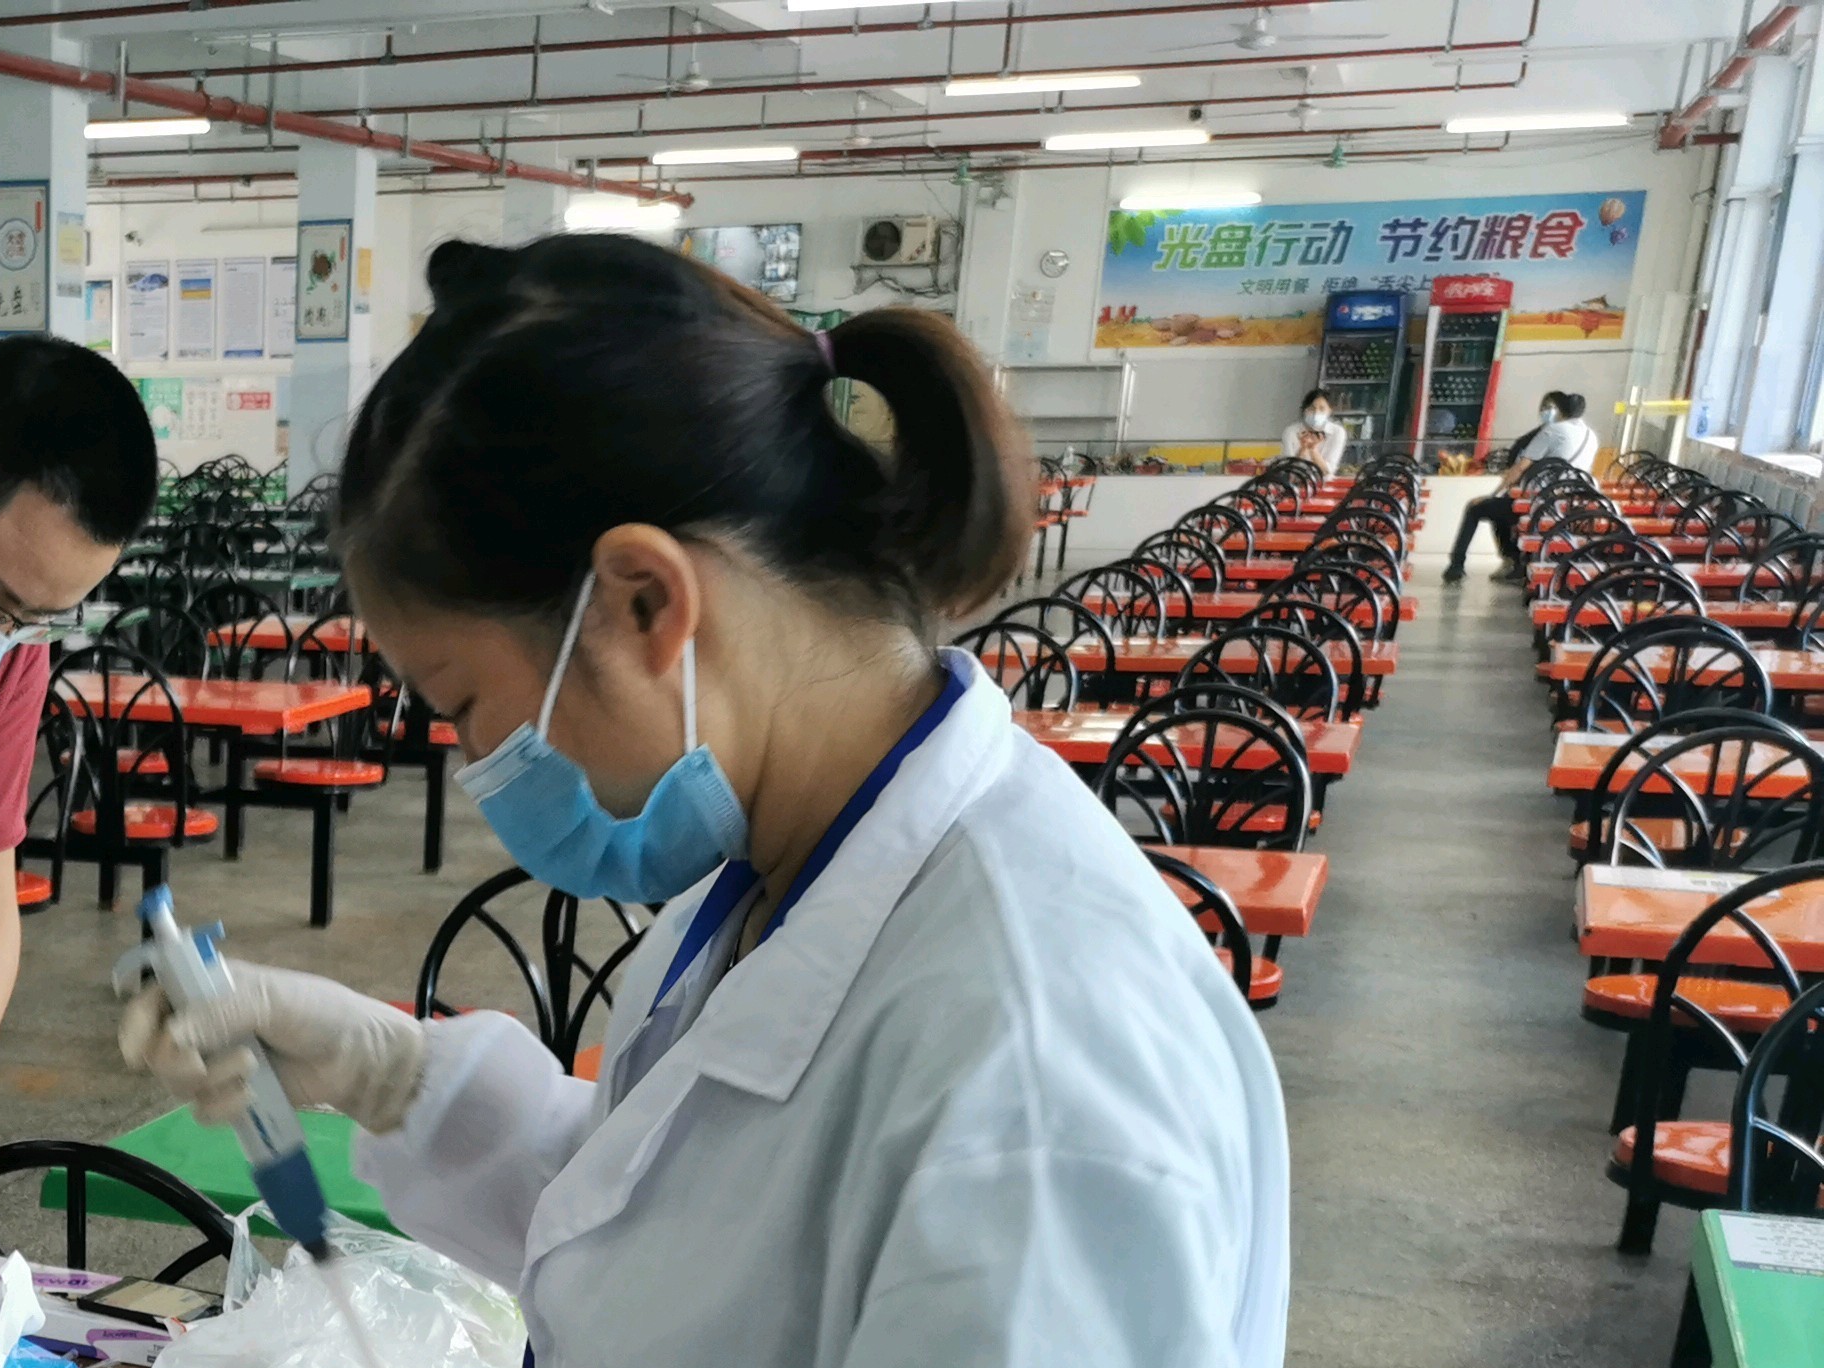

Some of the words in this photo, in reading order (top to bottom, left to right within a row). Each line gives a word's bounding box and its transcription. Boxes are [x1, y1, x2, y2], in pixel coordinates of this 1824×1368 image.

[1153, 218, 1353, 271] 光盘行动
[1377, 209, 1587, 264] 节约粮食
[1237, 276, 1310, 296] 文明用餐
